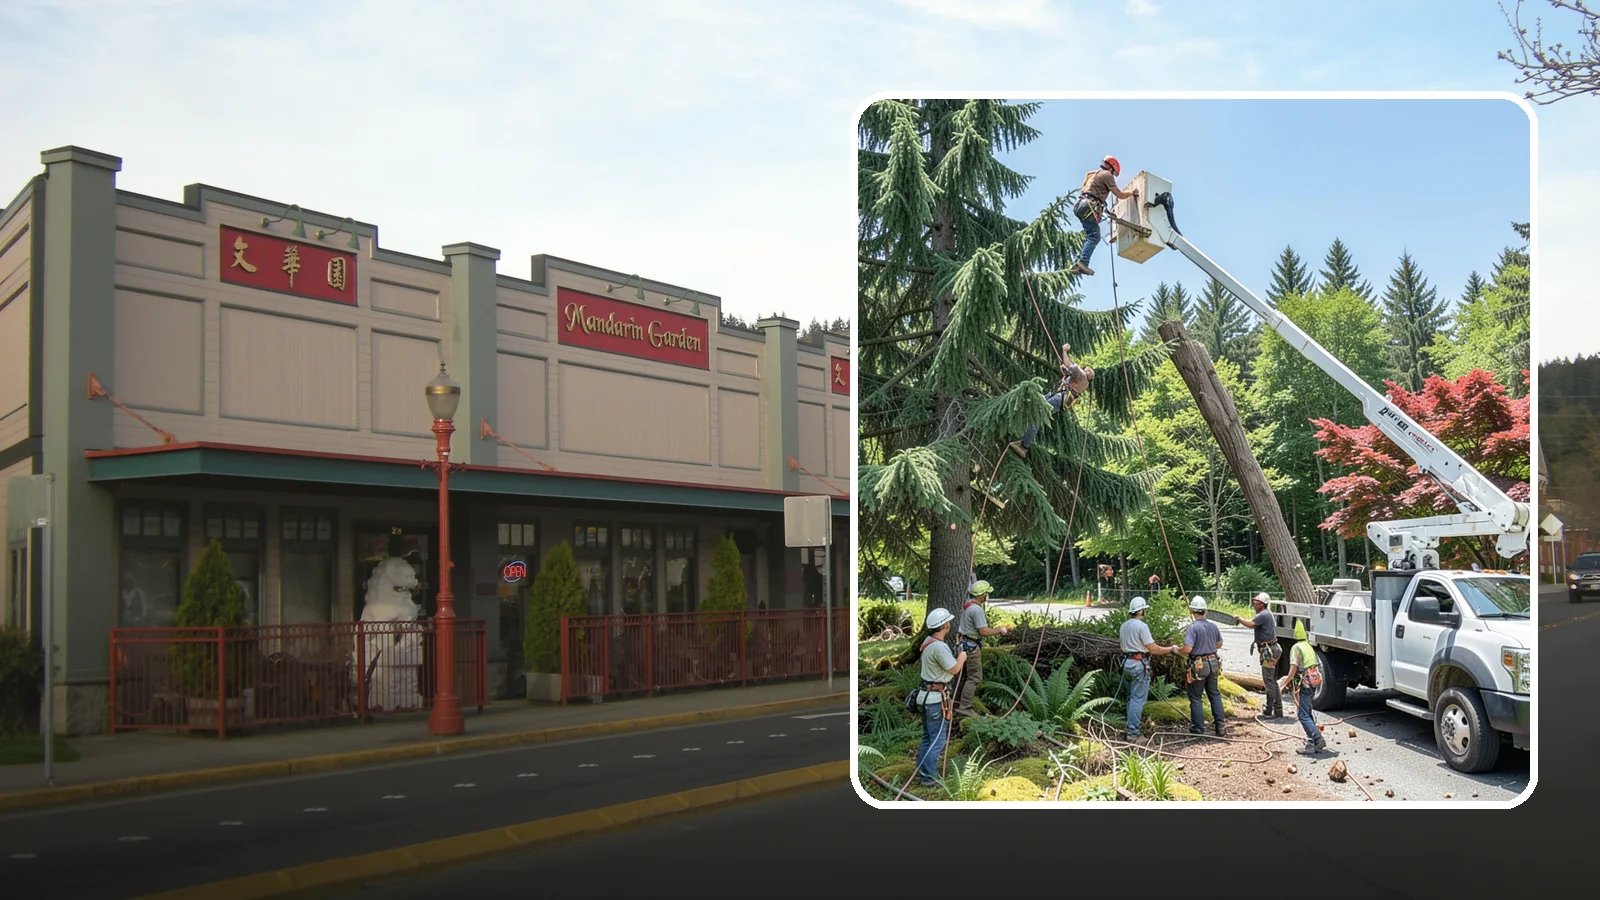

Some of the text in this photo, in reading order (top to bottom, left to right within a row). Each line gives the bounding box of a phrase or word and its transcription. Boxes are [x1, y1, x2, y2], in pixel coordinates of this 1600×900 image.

[230, 235, 347, 291] 文華園
[564, 302, 701, 352] Mandarin Garden
[503, 565, 527, 578] OPEN
